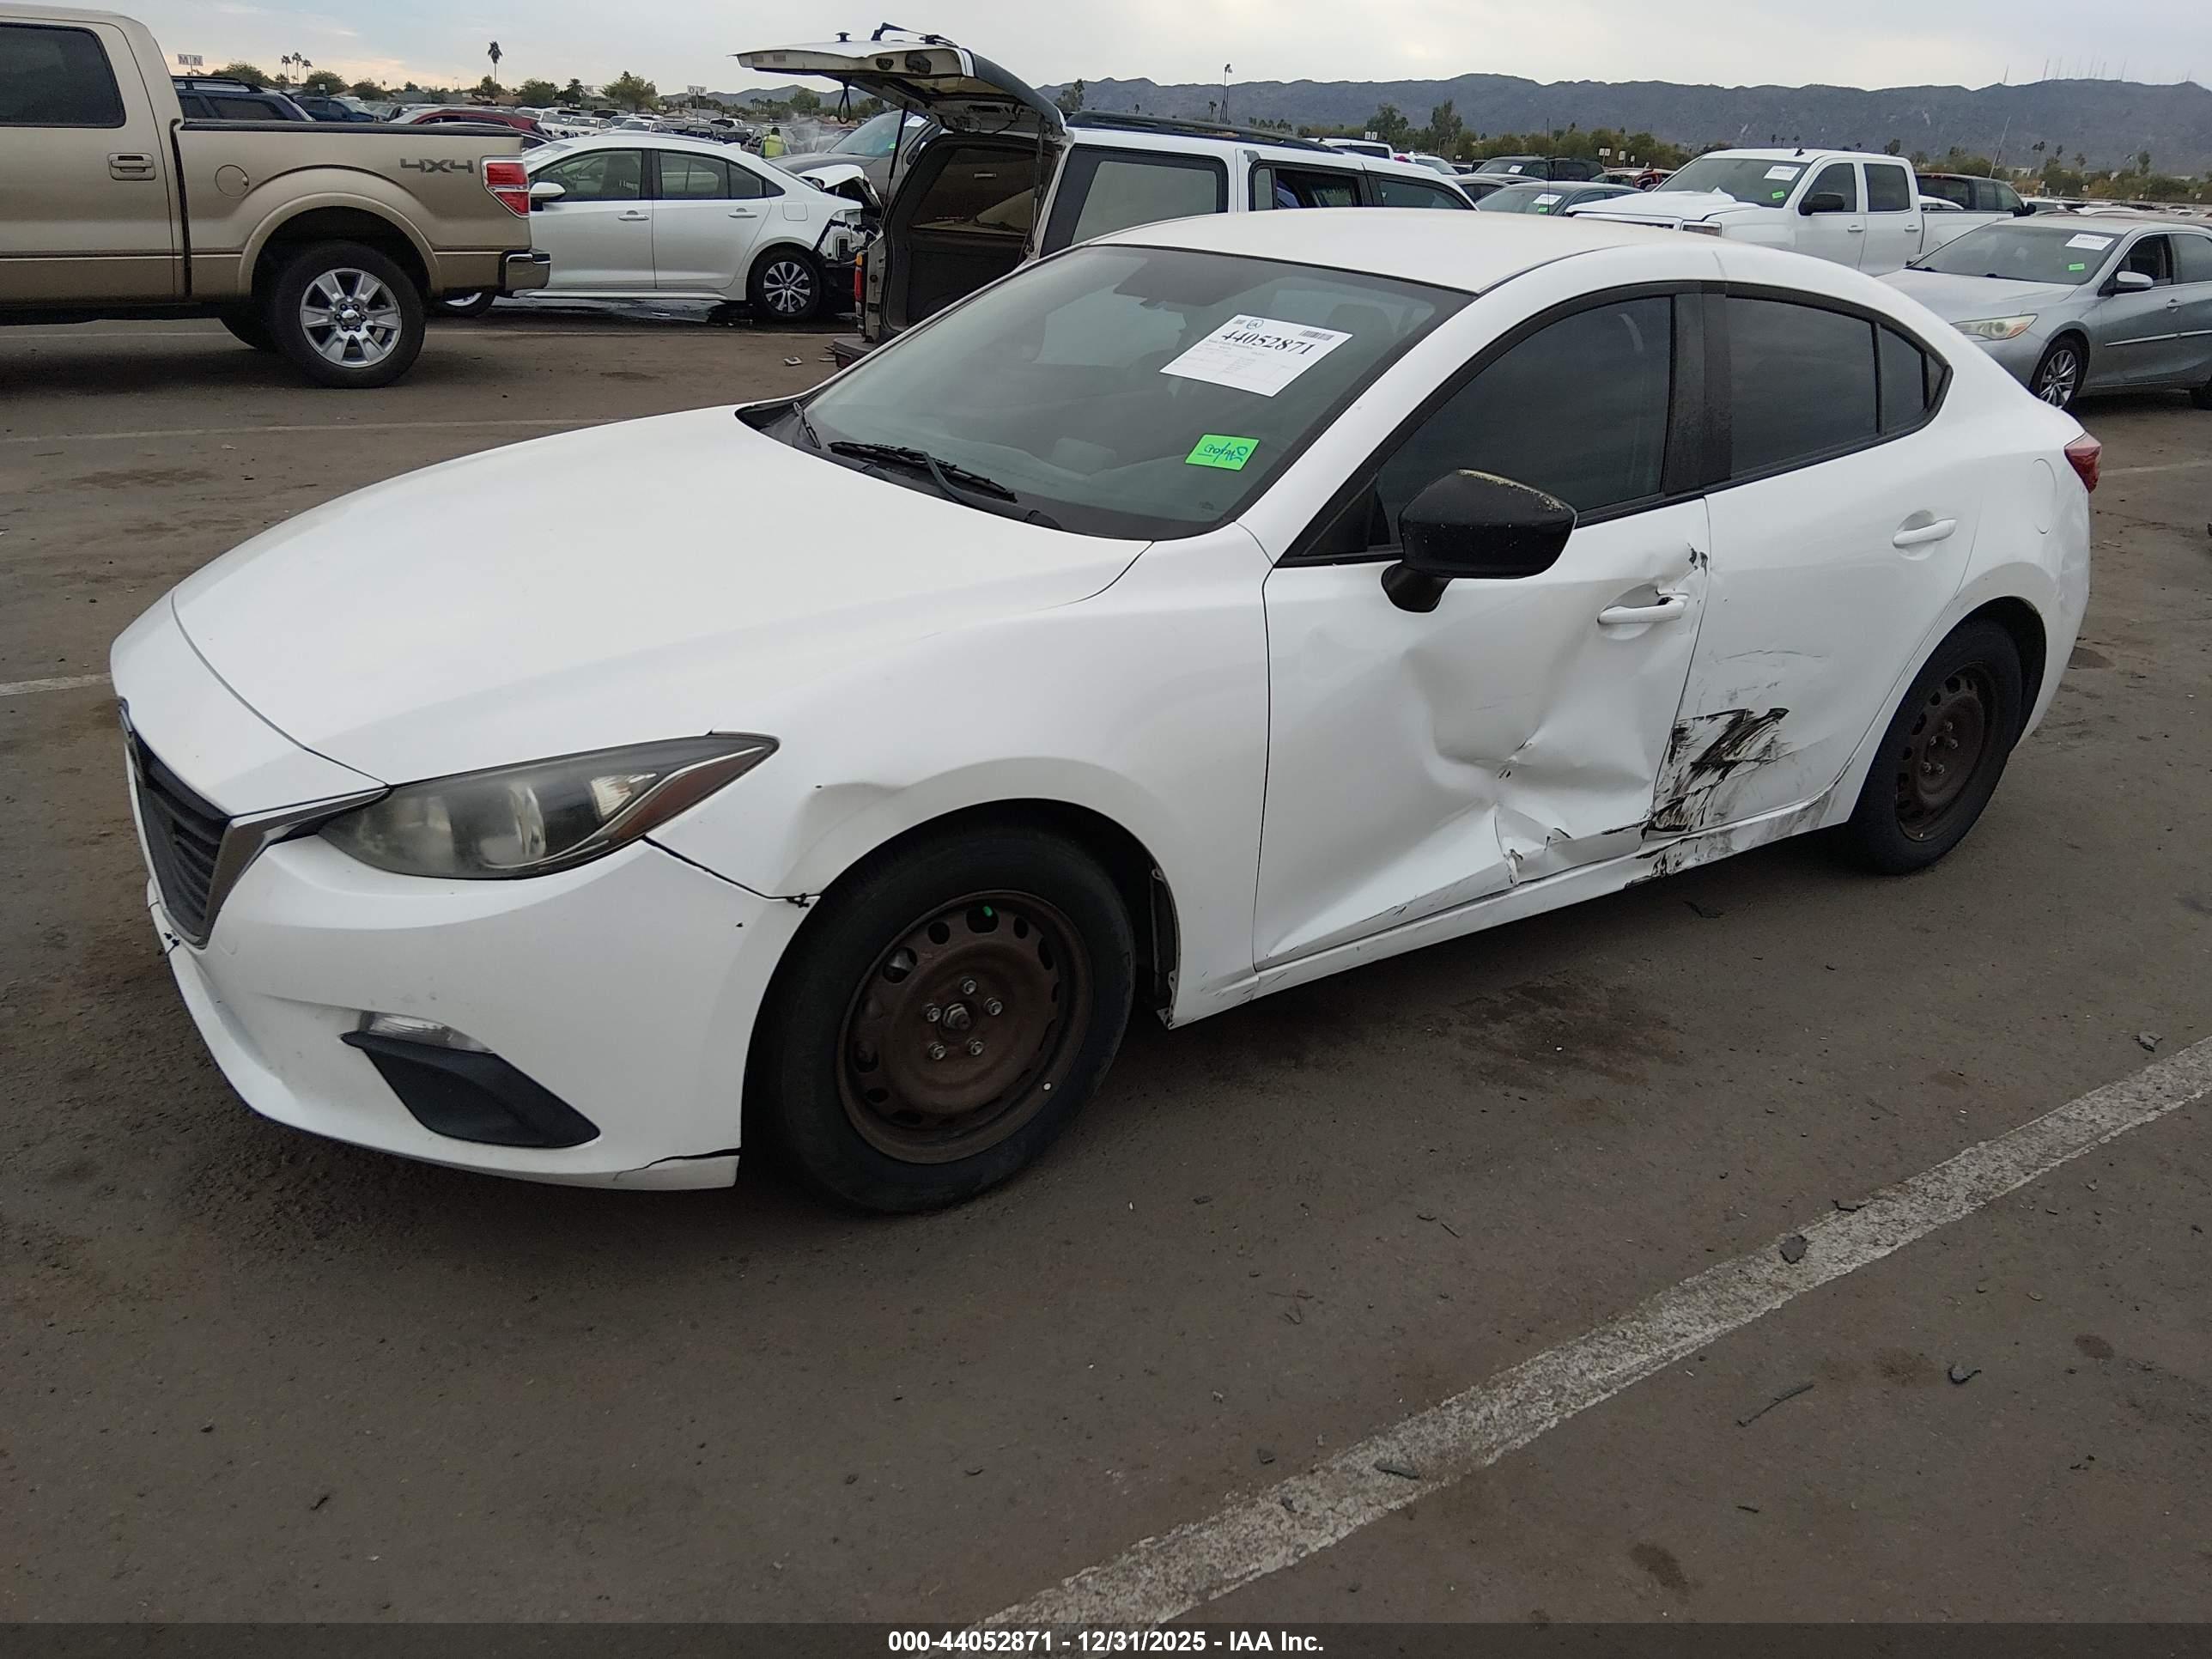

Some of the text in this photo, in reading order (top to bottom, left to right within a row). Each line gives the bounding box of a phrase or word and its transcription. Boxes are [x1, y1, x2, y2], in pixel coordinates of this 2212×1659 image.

[179, 55, 188, 64] M
[400, 158, 474, 173] 4X4
[1222, 331, 1316, 355] 44052871
